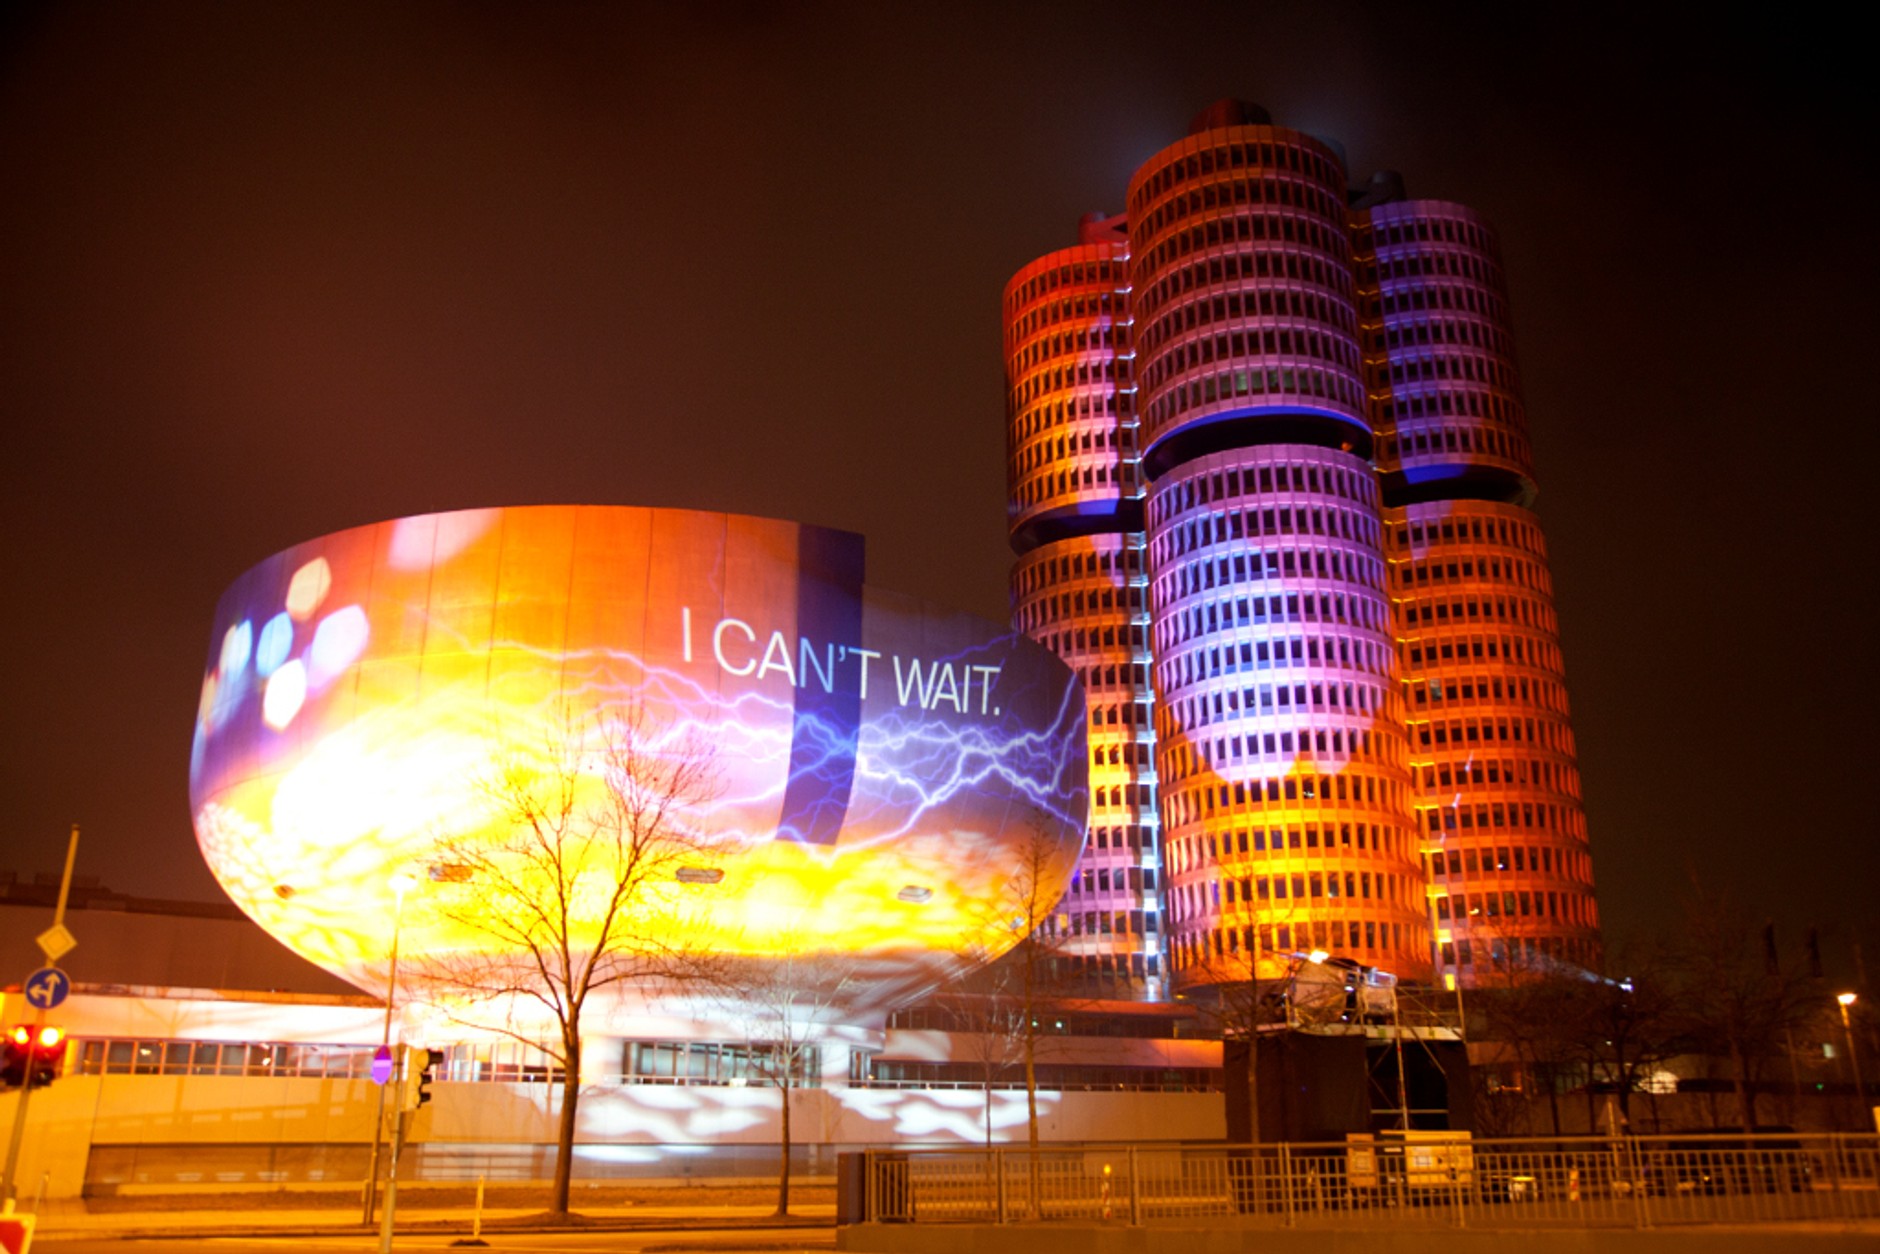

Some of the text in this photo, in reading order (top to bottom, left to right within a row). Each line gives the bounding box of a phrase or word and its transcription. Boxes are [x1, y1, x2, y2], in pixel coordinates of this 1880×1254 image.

[682, 606, 1001, 716] I CAN'T WAIT.
